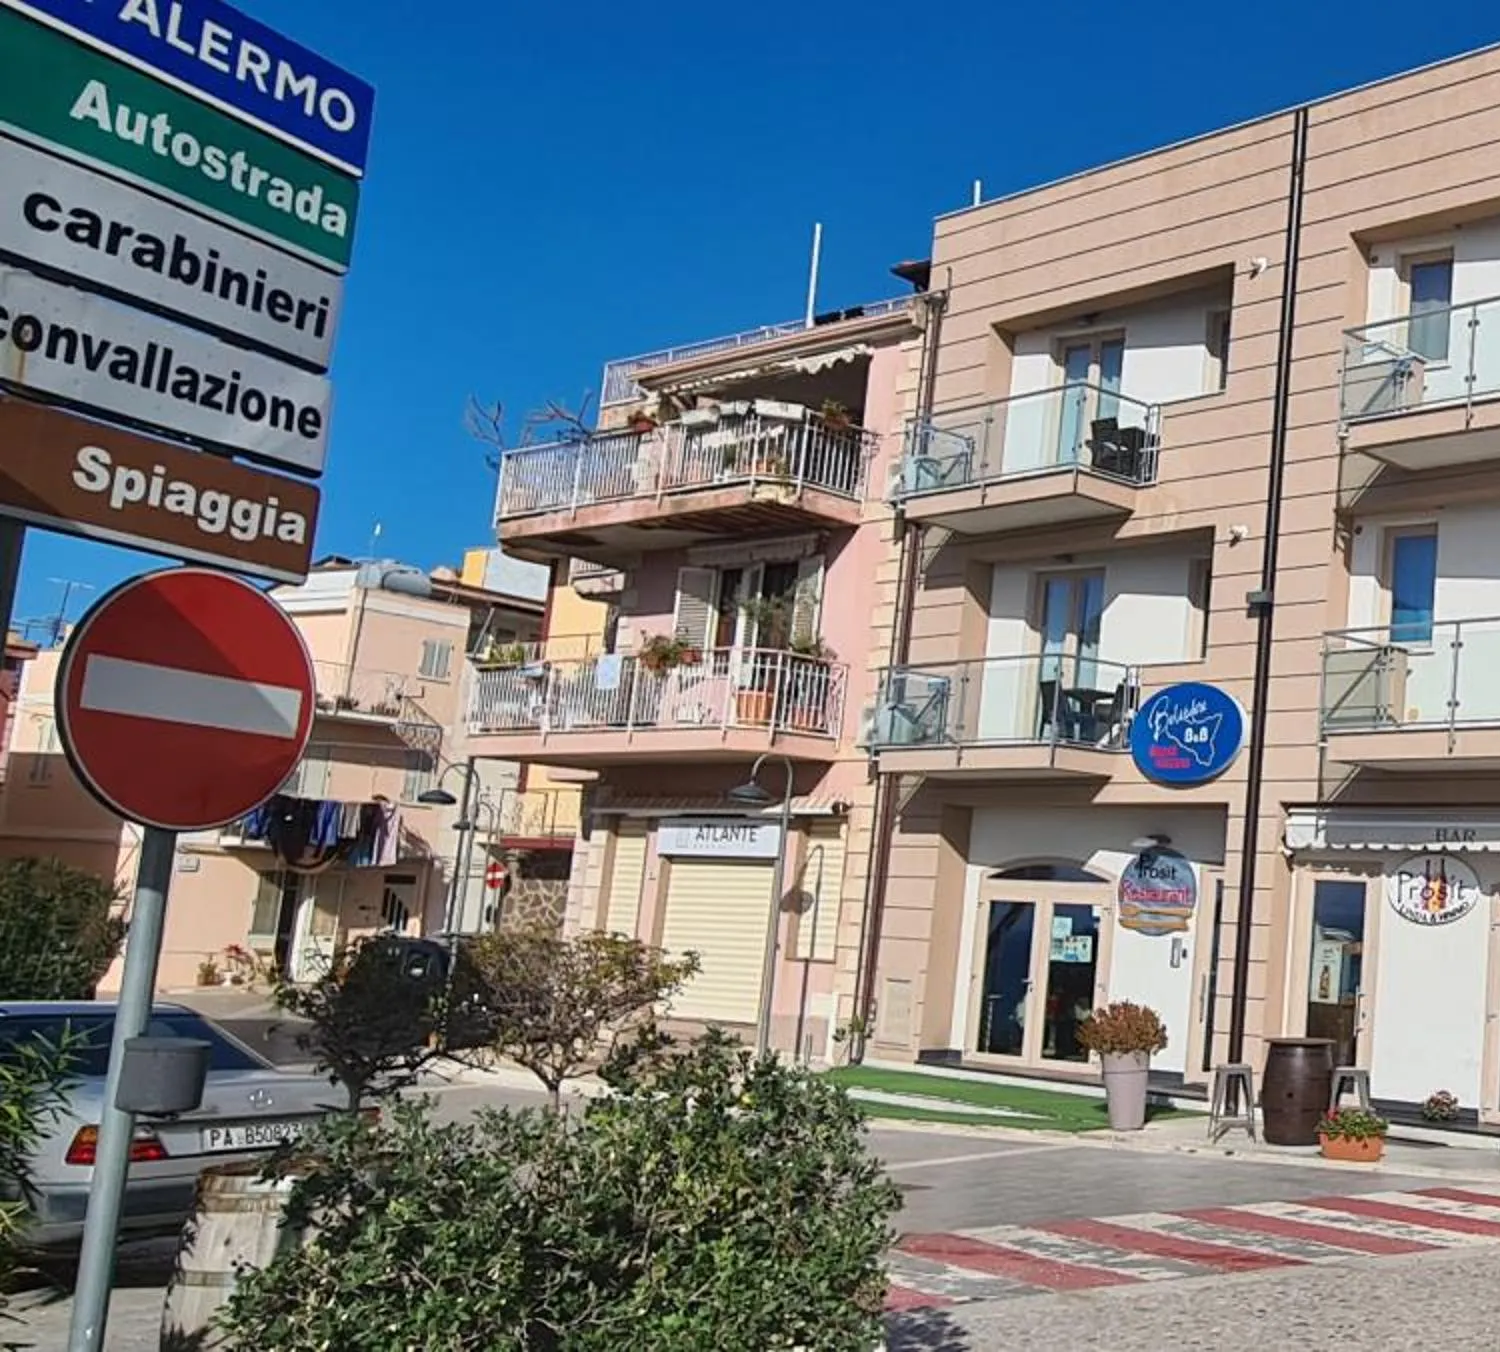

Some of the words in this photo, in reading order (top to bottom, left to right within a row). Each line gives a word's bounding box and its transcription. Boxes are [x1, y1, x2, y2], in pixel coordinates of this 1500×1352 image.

[84, 0, 357, 133] ALERMO
[69, 79, 348, 238] Autostrada
[22, 191, 329, 338] carabinieri
[72, 444, 306, 545] Spiaggia
[696, 823, 757, 843] ATLANTE
[1435, 828, 1477, 843] BAR
[1137, 851, 1177, 881] Prosit
[1397, 871, 1467, 904] Prosit
[209, 1127, 234, 1147] PA
